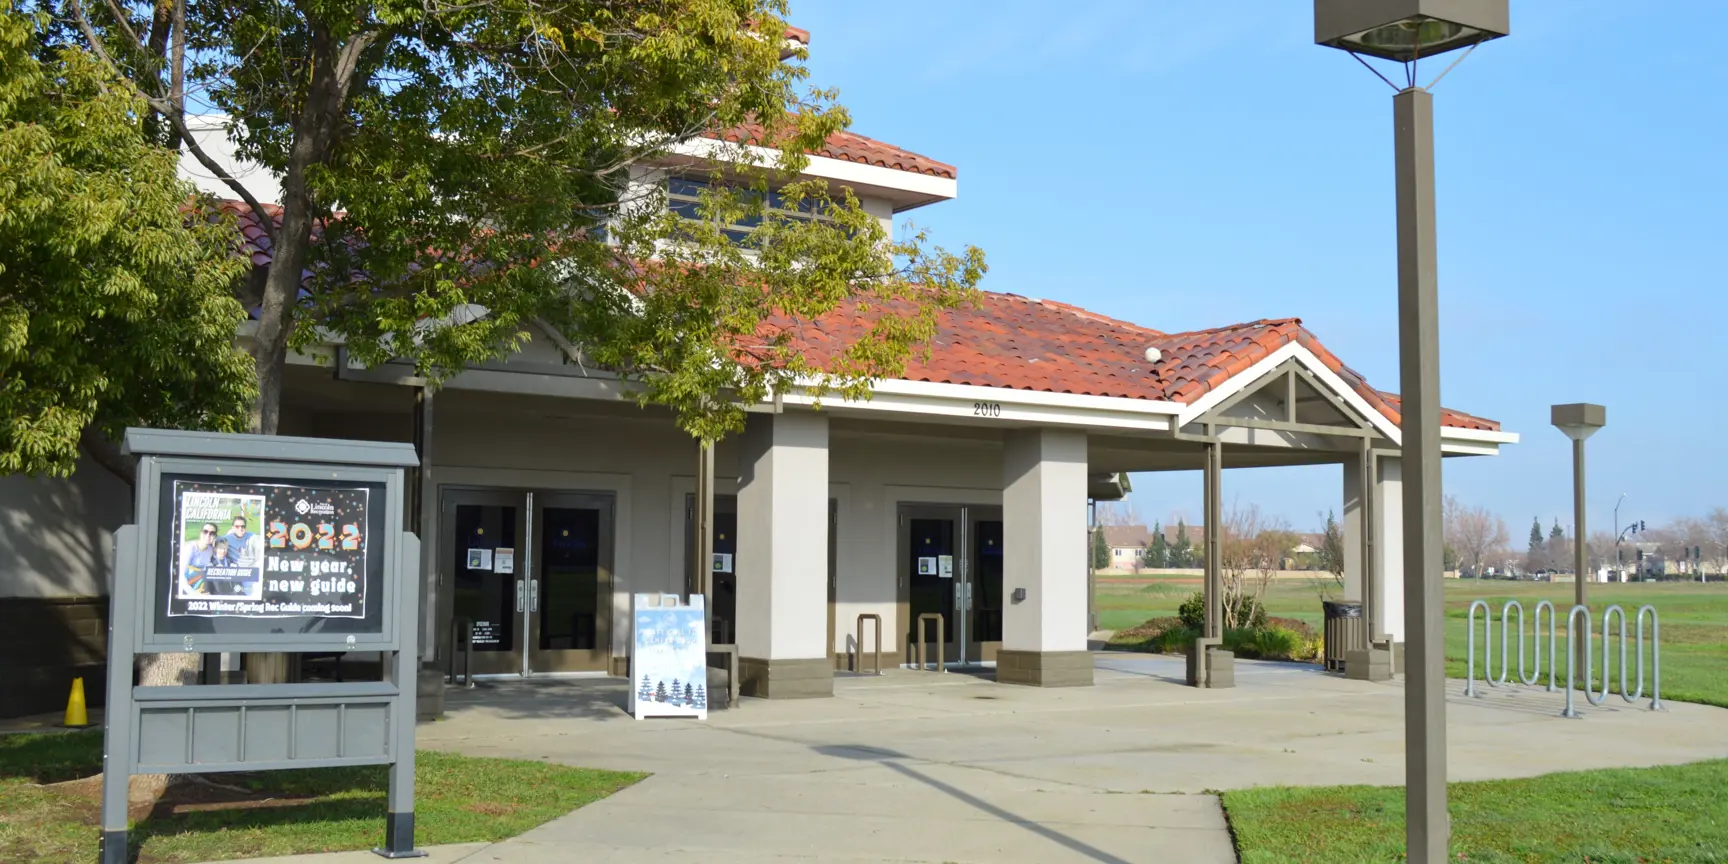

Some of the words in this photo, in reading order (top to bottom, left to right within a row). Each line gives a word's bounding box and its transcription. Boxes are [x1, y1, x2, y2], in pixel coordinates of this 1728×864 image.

[974, 402, 1001, 417] 2010
[186, 495, 220, 508] LINCOLN
[186, 508, 231, 520] CALIFORNIA
[269, 522, 359, 551] 2022
[206, 568, 237, 576] RECREATION
[236, 569, 252, 577] GUIDE
[267, 556, 304, 572] New
[310, 560, 352, 576] year,
[269, 579, 305, 592] new
[310, 577, 356, 596] guide
[188, 601, 208, 610] 2022
[265, 602, 279, 611] Rec
[280, 602, 301, 611] Guide
[302, 603, 330, 613] coming
[331, 603, 352, 612] soon!
